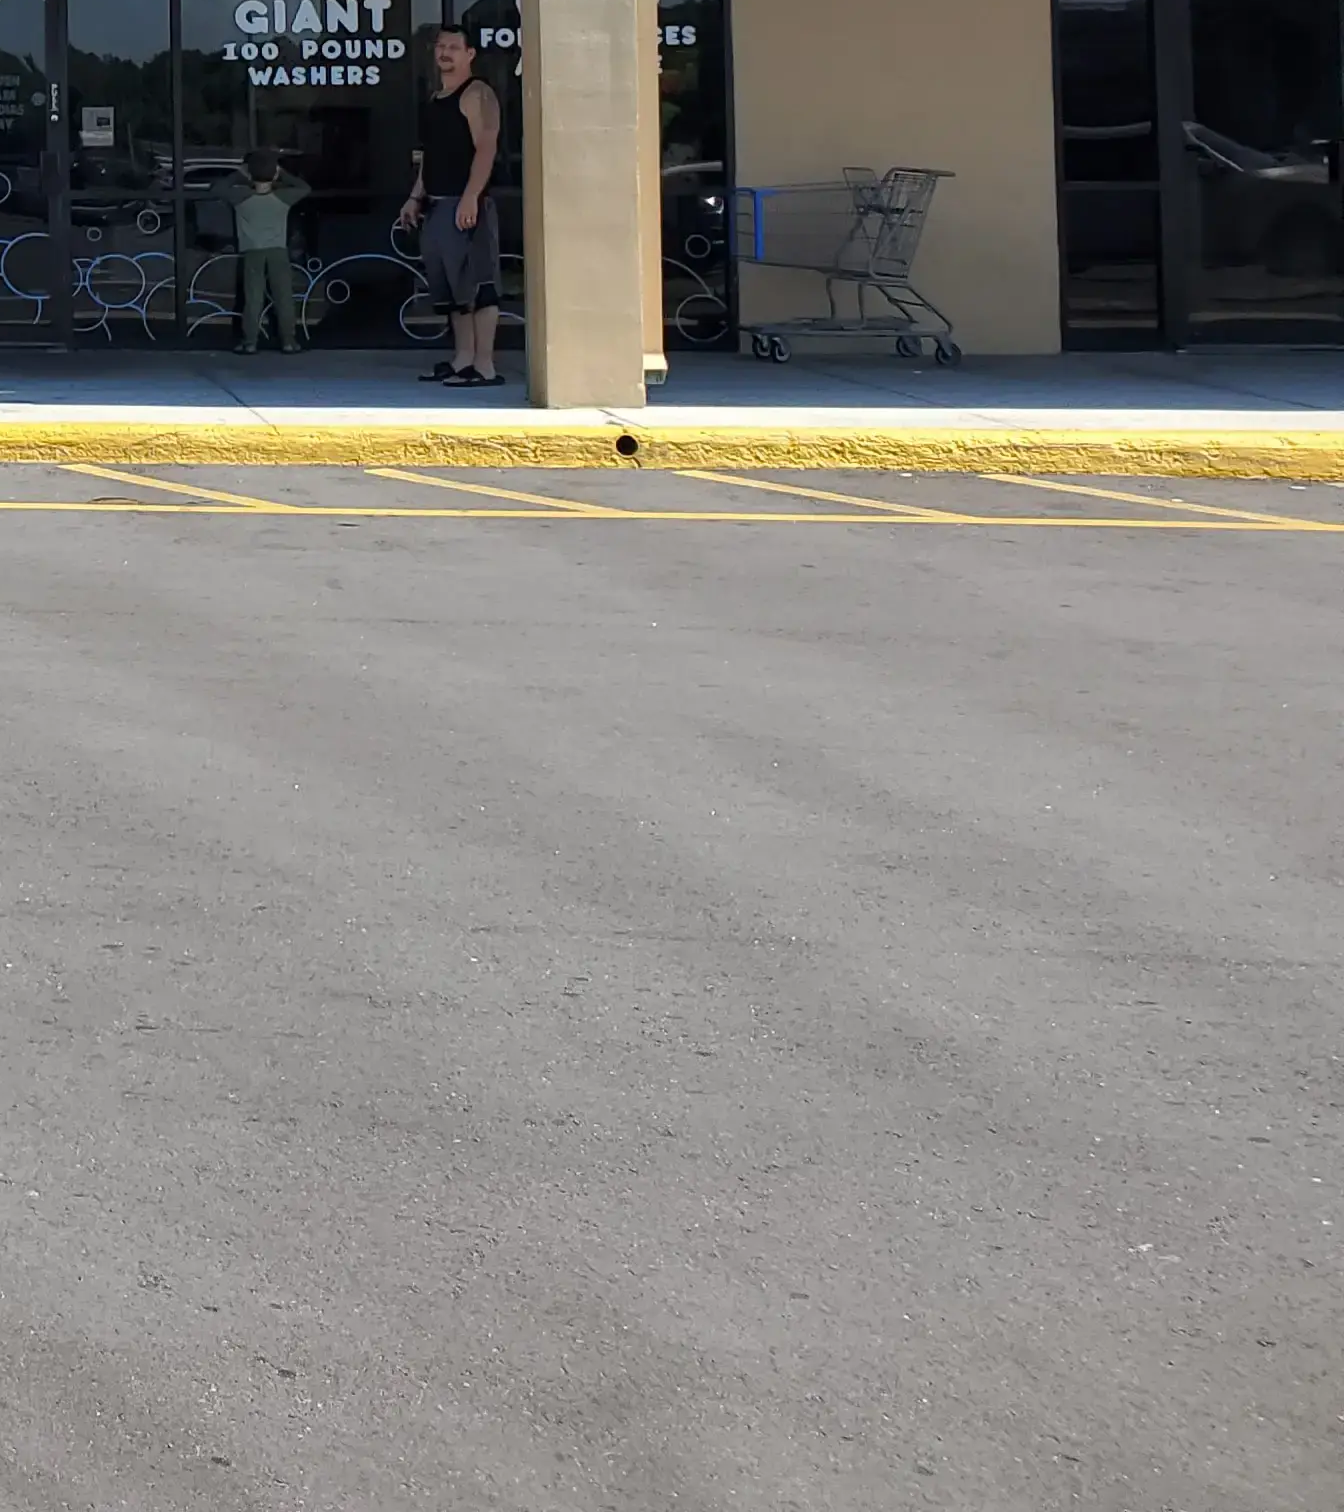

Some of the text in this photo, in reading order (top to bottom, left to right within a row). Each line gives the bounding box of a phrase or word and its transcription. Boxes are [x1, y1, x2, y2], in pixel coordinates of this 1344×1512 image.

[222, 39, 405, 60] 100 POUND
[248, 66, 380, 86] WASHERS
